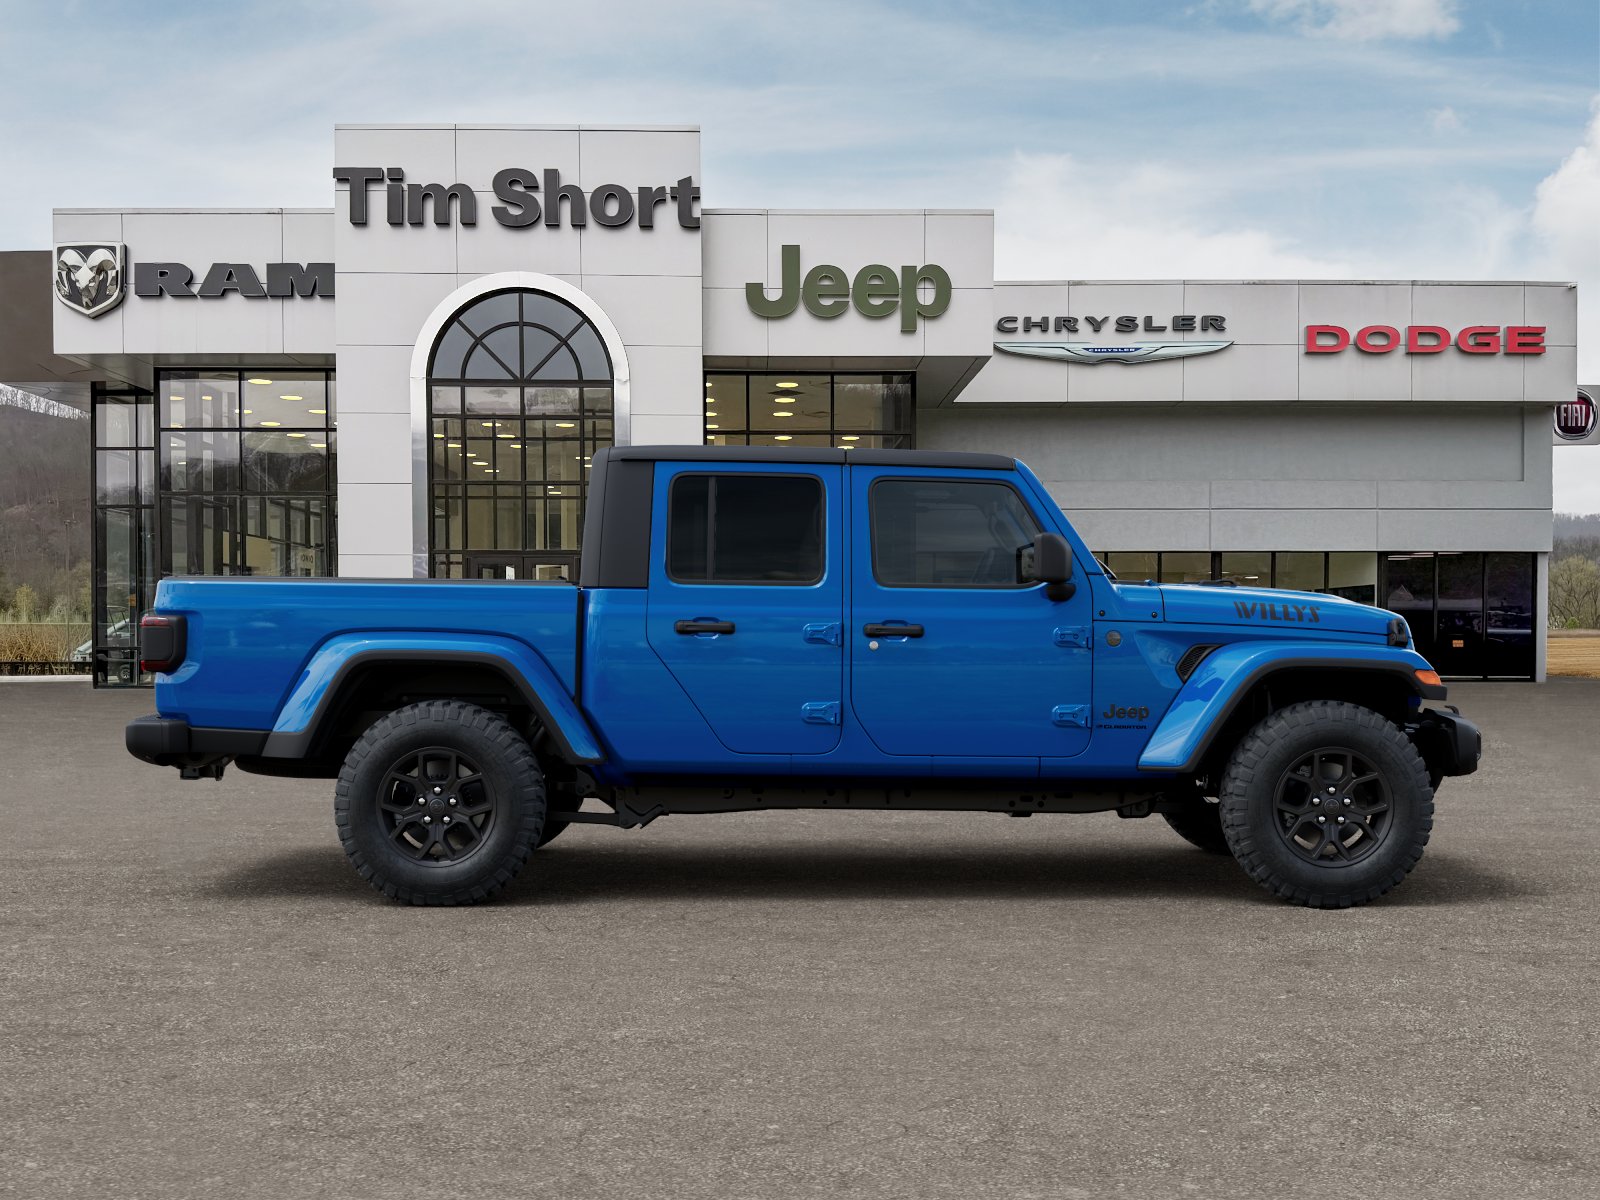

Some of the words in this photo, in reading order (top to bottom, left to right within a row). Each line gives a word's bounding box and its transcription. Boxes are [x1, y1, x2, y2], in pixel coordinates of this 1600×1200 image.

[333, 167, 476, 227] Tim
[491, 168, 701, 229] Short
[134, 263, 335, 298] RAM
[745, 245, 952, 332] Jeep
[997, 315, 1227, 333] CHRYSLER
[1305, 325, 1547, 354] DODGE
[1560, 404, 1586, 427] FIAT
[1234, 601, 1320, 623] WILLYS
[1103, 703, 1150, 721] Jeep
